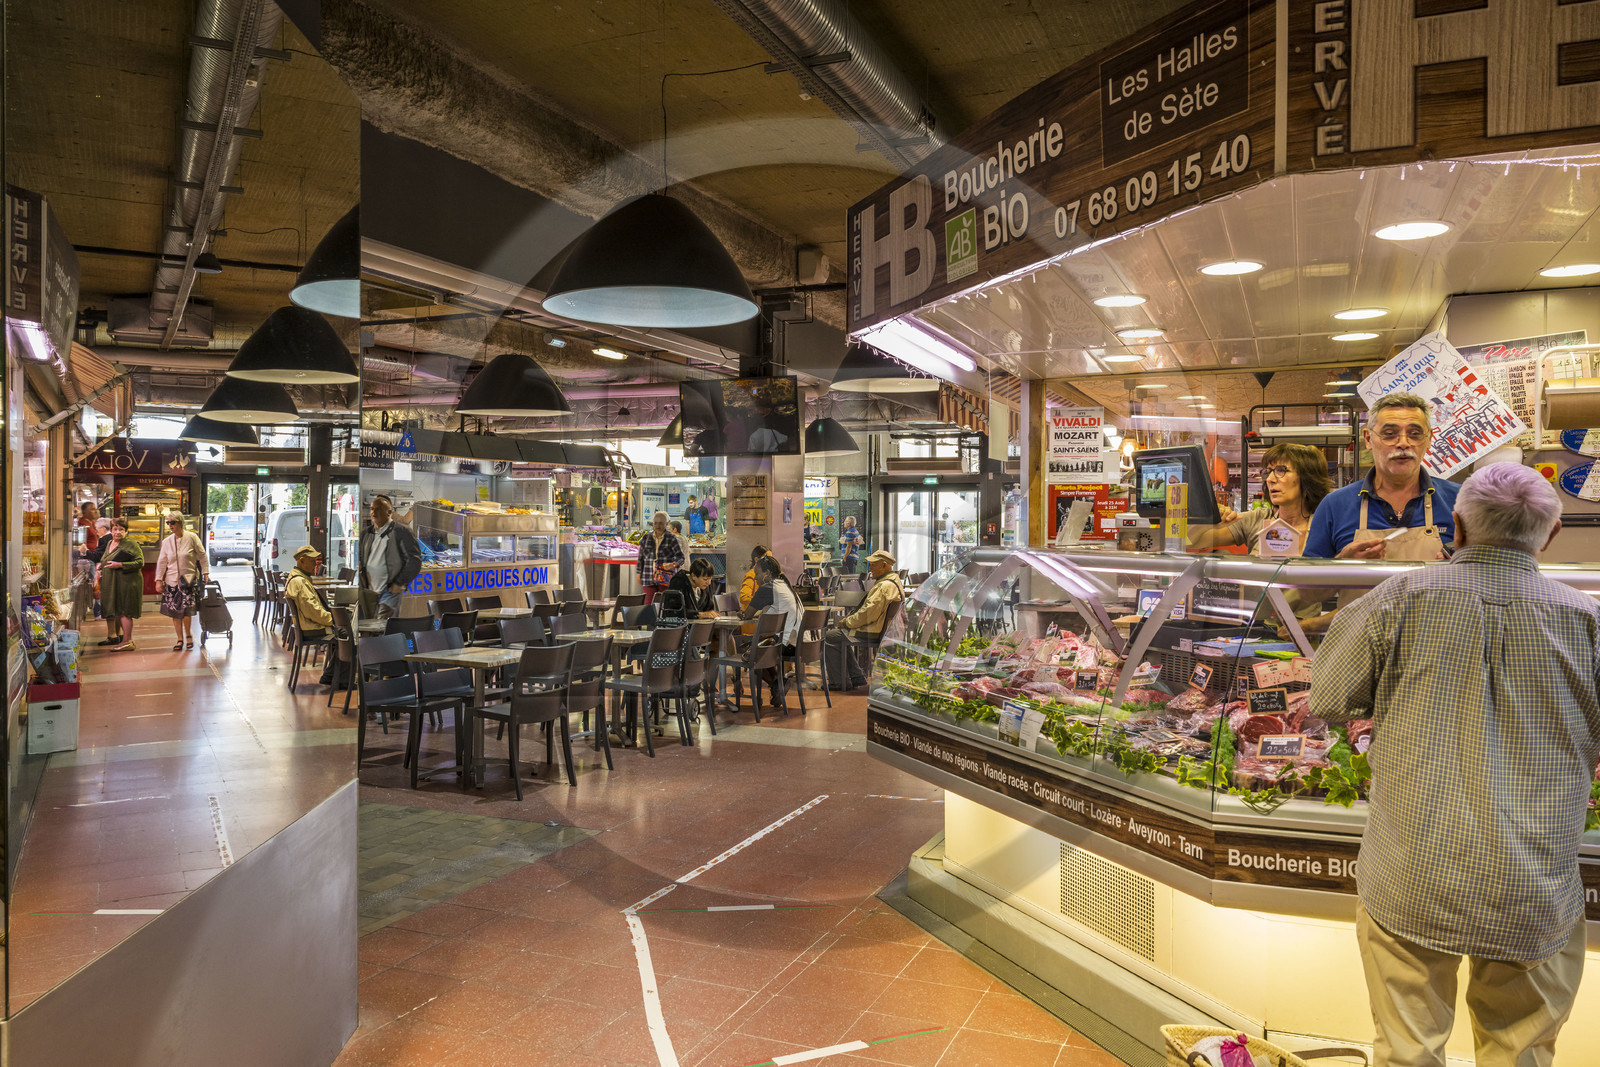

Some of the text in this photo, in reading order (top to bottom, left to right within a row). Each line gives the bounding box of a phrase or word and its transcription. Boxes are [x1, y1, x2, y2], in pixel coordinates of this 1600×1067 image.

[1108, 25, 1238, 106] Les Halles
[1124, 82, 1220, 140] de Sète
[944, 117, 1064, 212] Boucherie
[1054, 134, 1250, 239] 07 68 09 15 40
[861, 173, 937, 319] HB
[950, 227, 973, 263] AB
[1481, 344, 1533, 360] Porc
[1383, 352, 1436, 395] SAINT LOUIS
[1403, 371, 1428, 392] 2020
[1053, 417, 1101, 427] VIVALDI
[1054, 432, 1099, 440] MOZART
[1171, 486, 1181, 505] CB
[445, 567, 549, 592] BOUZIGUES.COM
[873, 722, 1203, 860] Boucherie BIO Viande de nos régions Viande racée Circuit court Lozère Aveyron Tarn
[1228, 848, 1322, 875] Boucherie
